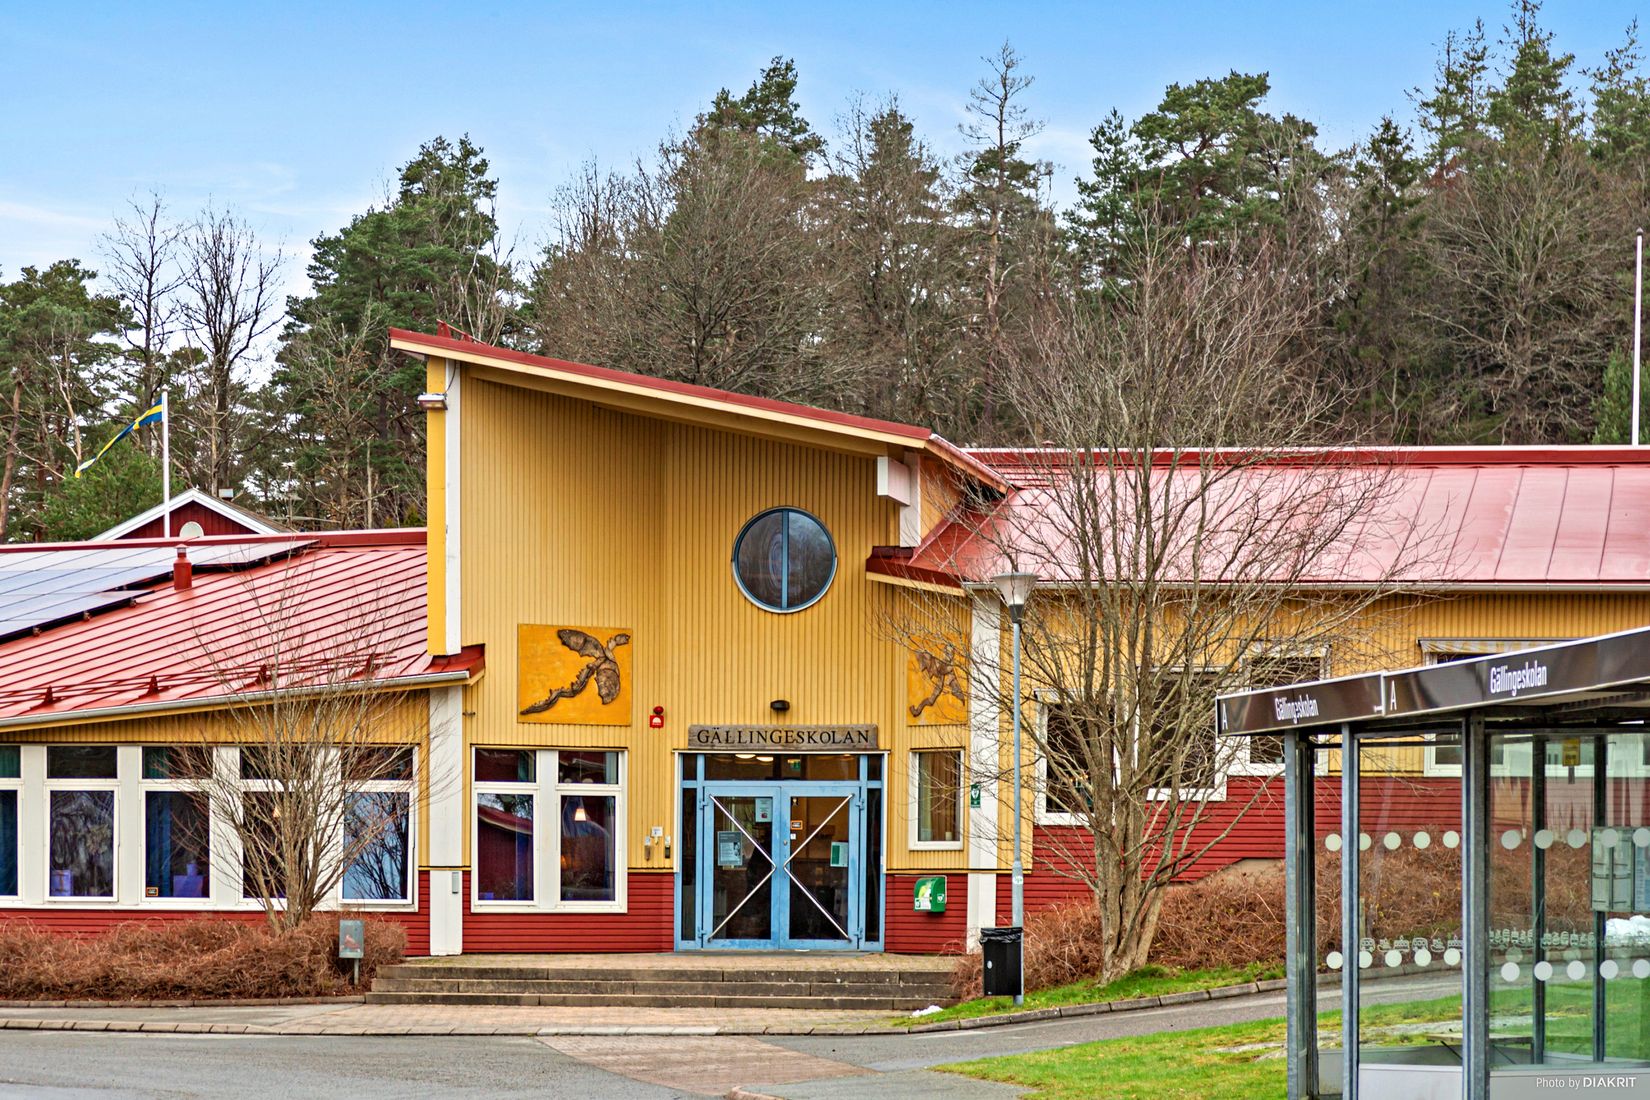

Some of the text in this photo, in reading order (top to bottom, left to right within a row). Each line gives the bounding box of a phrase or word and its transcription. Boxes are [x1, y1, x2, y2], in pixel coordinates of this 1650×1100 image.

[1489, 660, 1548, 697] Gällingeskolan
[1275, 694, 1320, 724] Gällingeskolan
[1389, 680, 1398, 711] A
[1221, 703, 1229, 730] A
[697, 727, 870, 745] GÄLLINGESKOLAN
